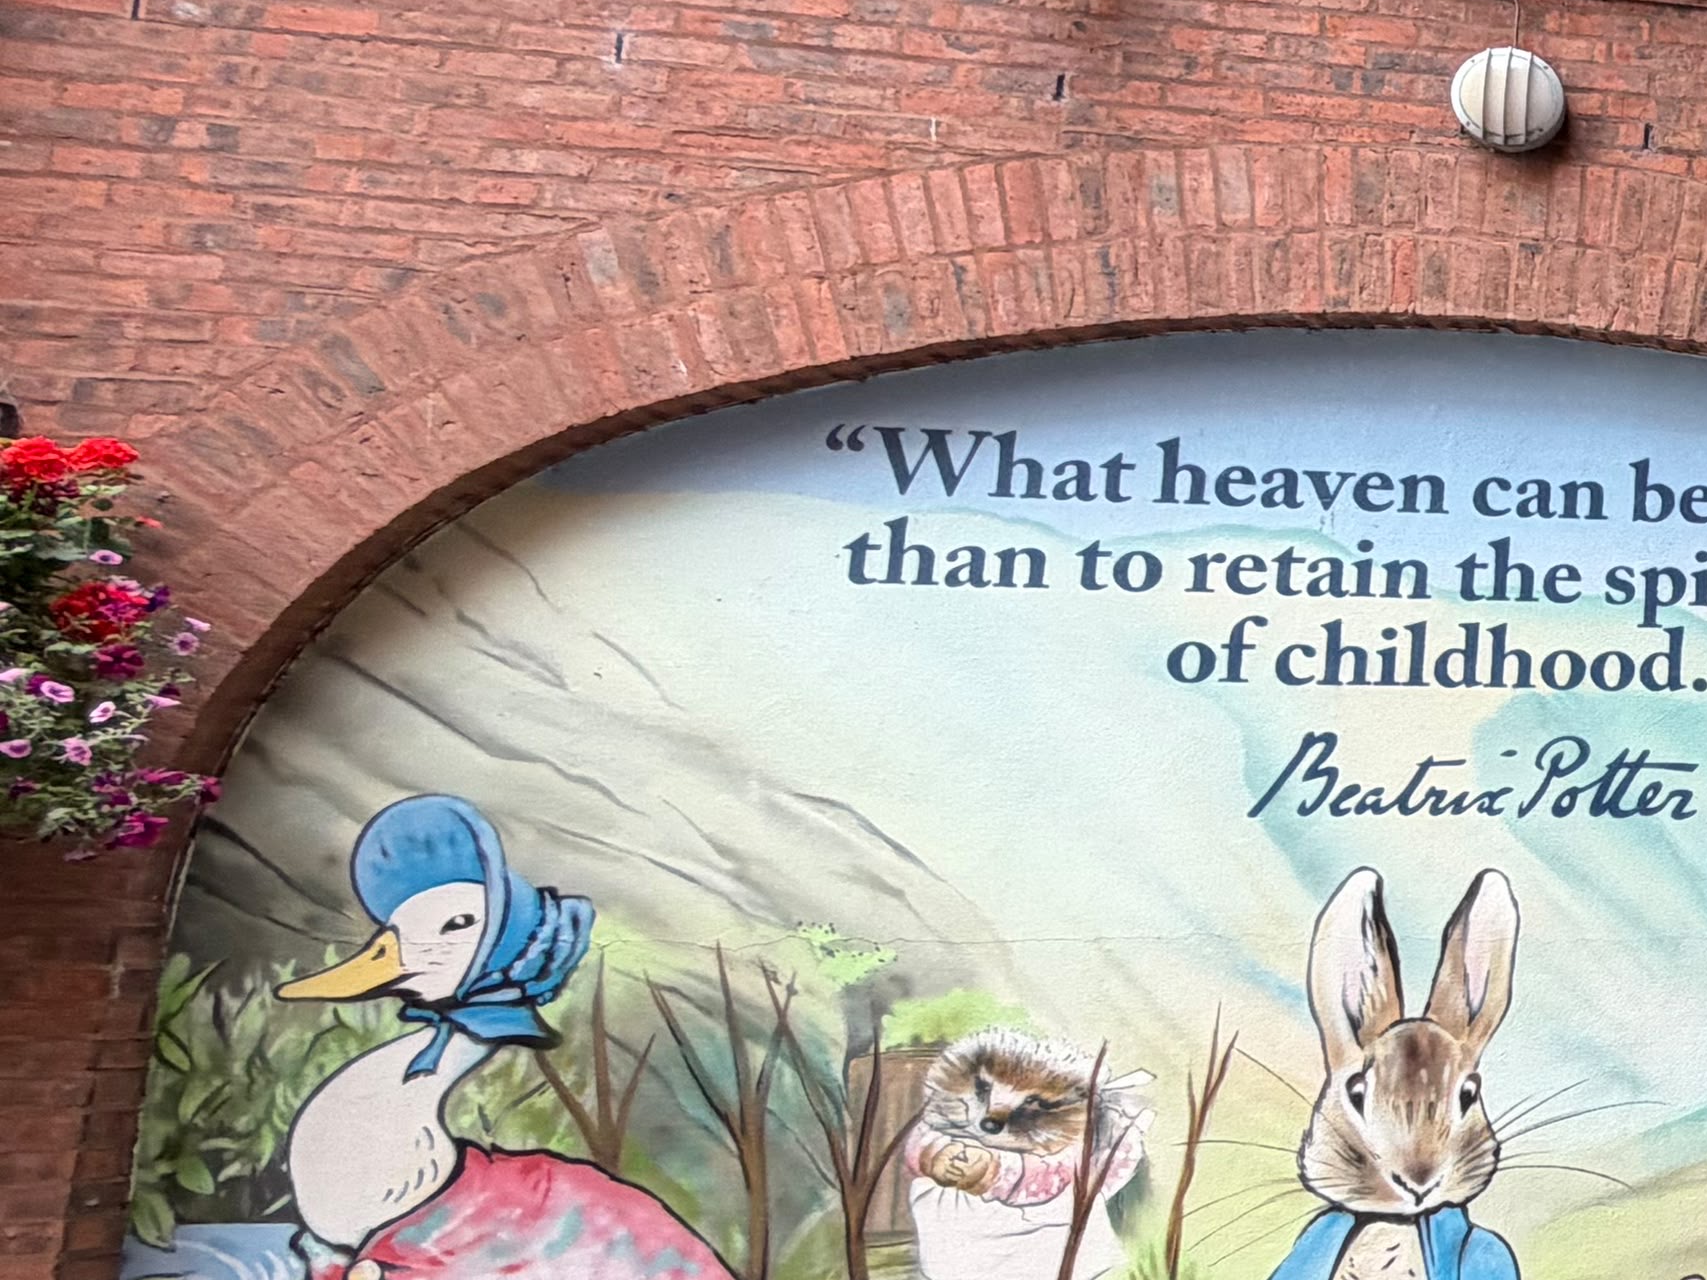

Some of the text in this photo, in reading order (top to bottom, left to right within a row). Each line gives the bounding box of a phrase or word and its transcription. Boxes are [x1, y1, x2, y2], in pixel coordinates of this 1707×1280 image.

[1152, 436, 1449, 515] heaven
[1472, 475, 1608, 521] can
[842, 516, 1049, 590] than
[1076, 539, 1164, 593] to
[1183, 539, 1432, 601] retain
[1455, 537, 1582, 605] the
[1166, 615, 1268, 684] of
[1247, 730, 1518, 818] Beatrix
[1518, 735, 1699, 820] Potter
